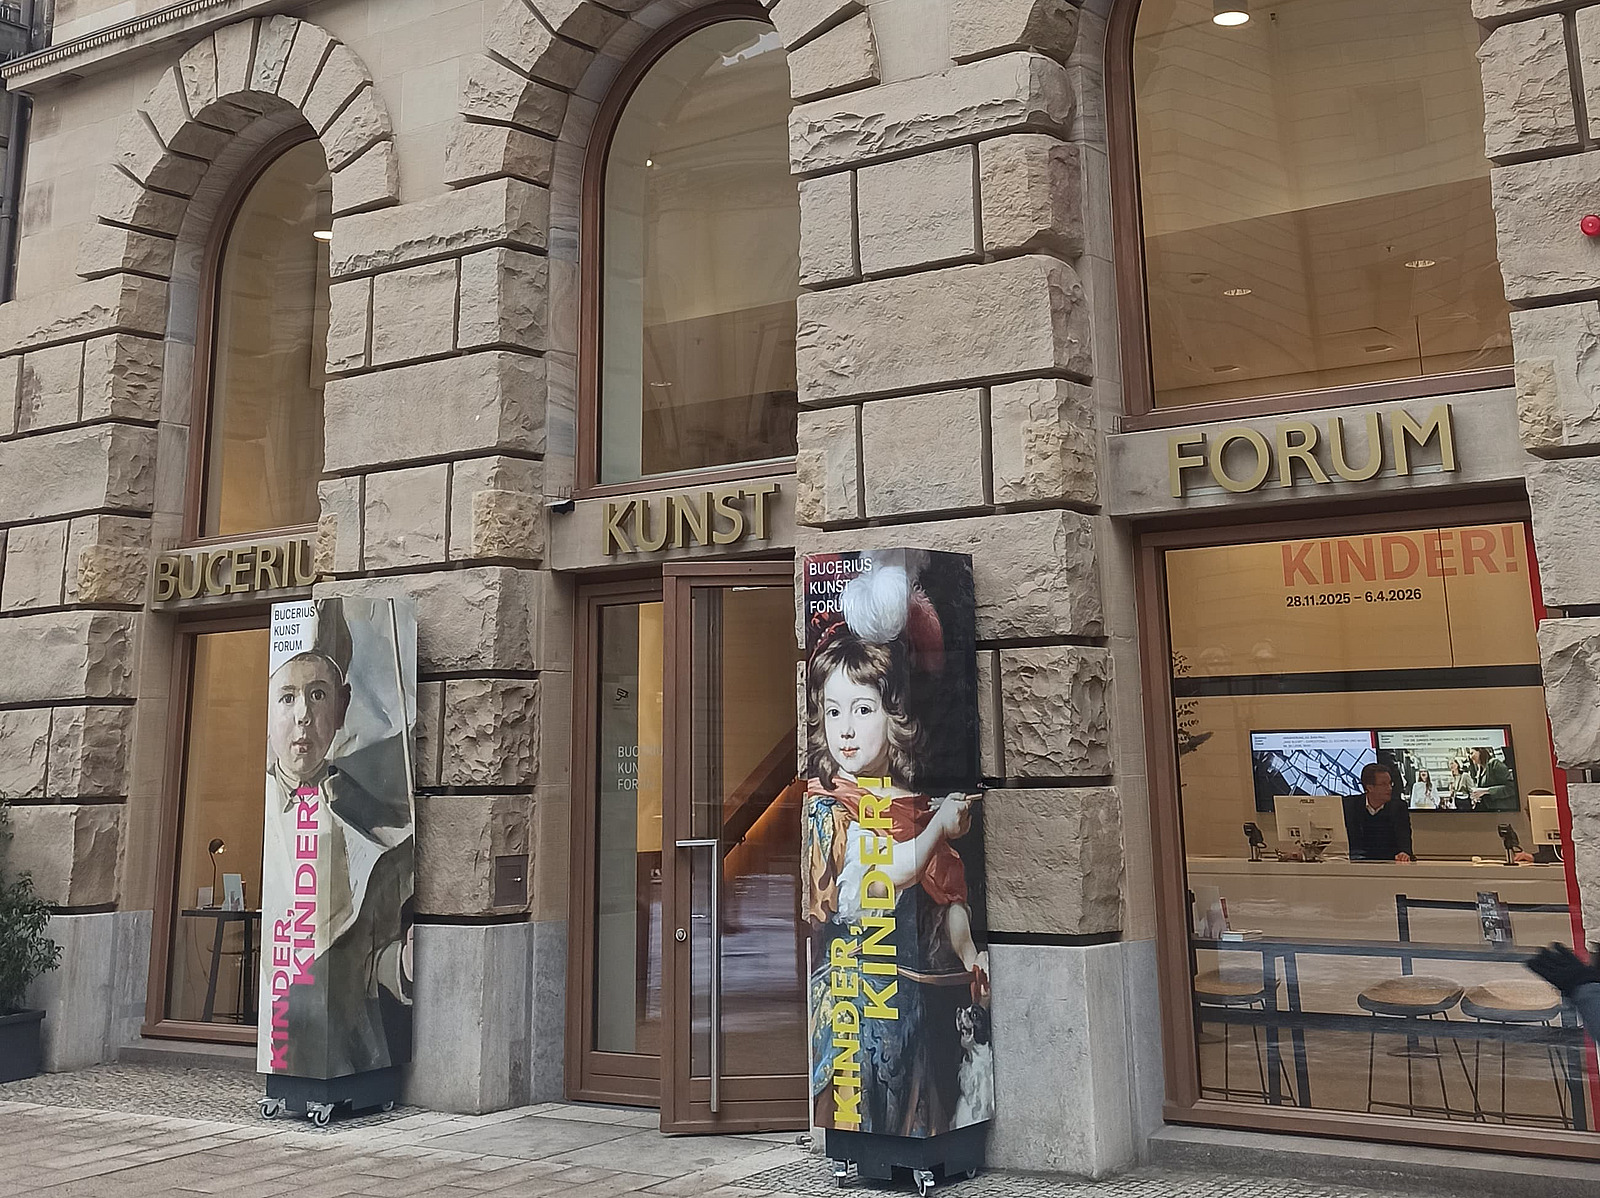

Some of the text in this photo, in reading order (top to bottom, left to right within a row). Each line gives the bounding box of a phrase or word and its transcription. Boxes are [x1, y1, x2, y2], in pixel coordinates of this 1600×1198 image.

[1168, 403, 1459, 498] FORUM
[603, 483, 780, 556] KUNST
[153, 539, 336, 602] BUCERIU
[809, 558, 873, 576] BUCERIUS
[809, 579, 851, 595] KUNST
[1281, 526, 1518, 587] KINDER!
[274, 606, 316, 621] BUCERIUS
[1286, 592, 1351, 607] 28.11.2025
[1364, 588, 1422, 602] 6.4.2026
[273, 623, 301, 637] KUNST
[273, 640, 303, 652] FORUM
[292, 786, 320, 985] KINDER!
[857, 776, 899, 1020] KINDER!
[270, 909, 295, 1070] KINDER,
[831, 925, 865, 1124] KINDER,
